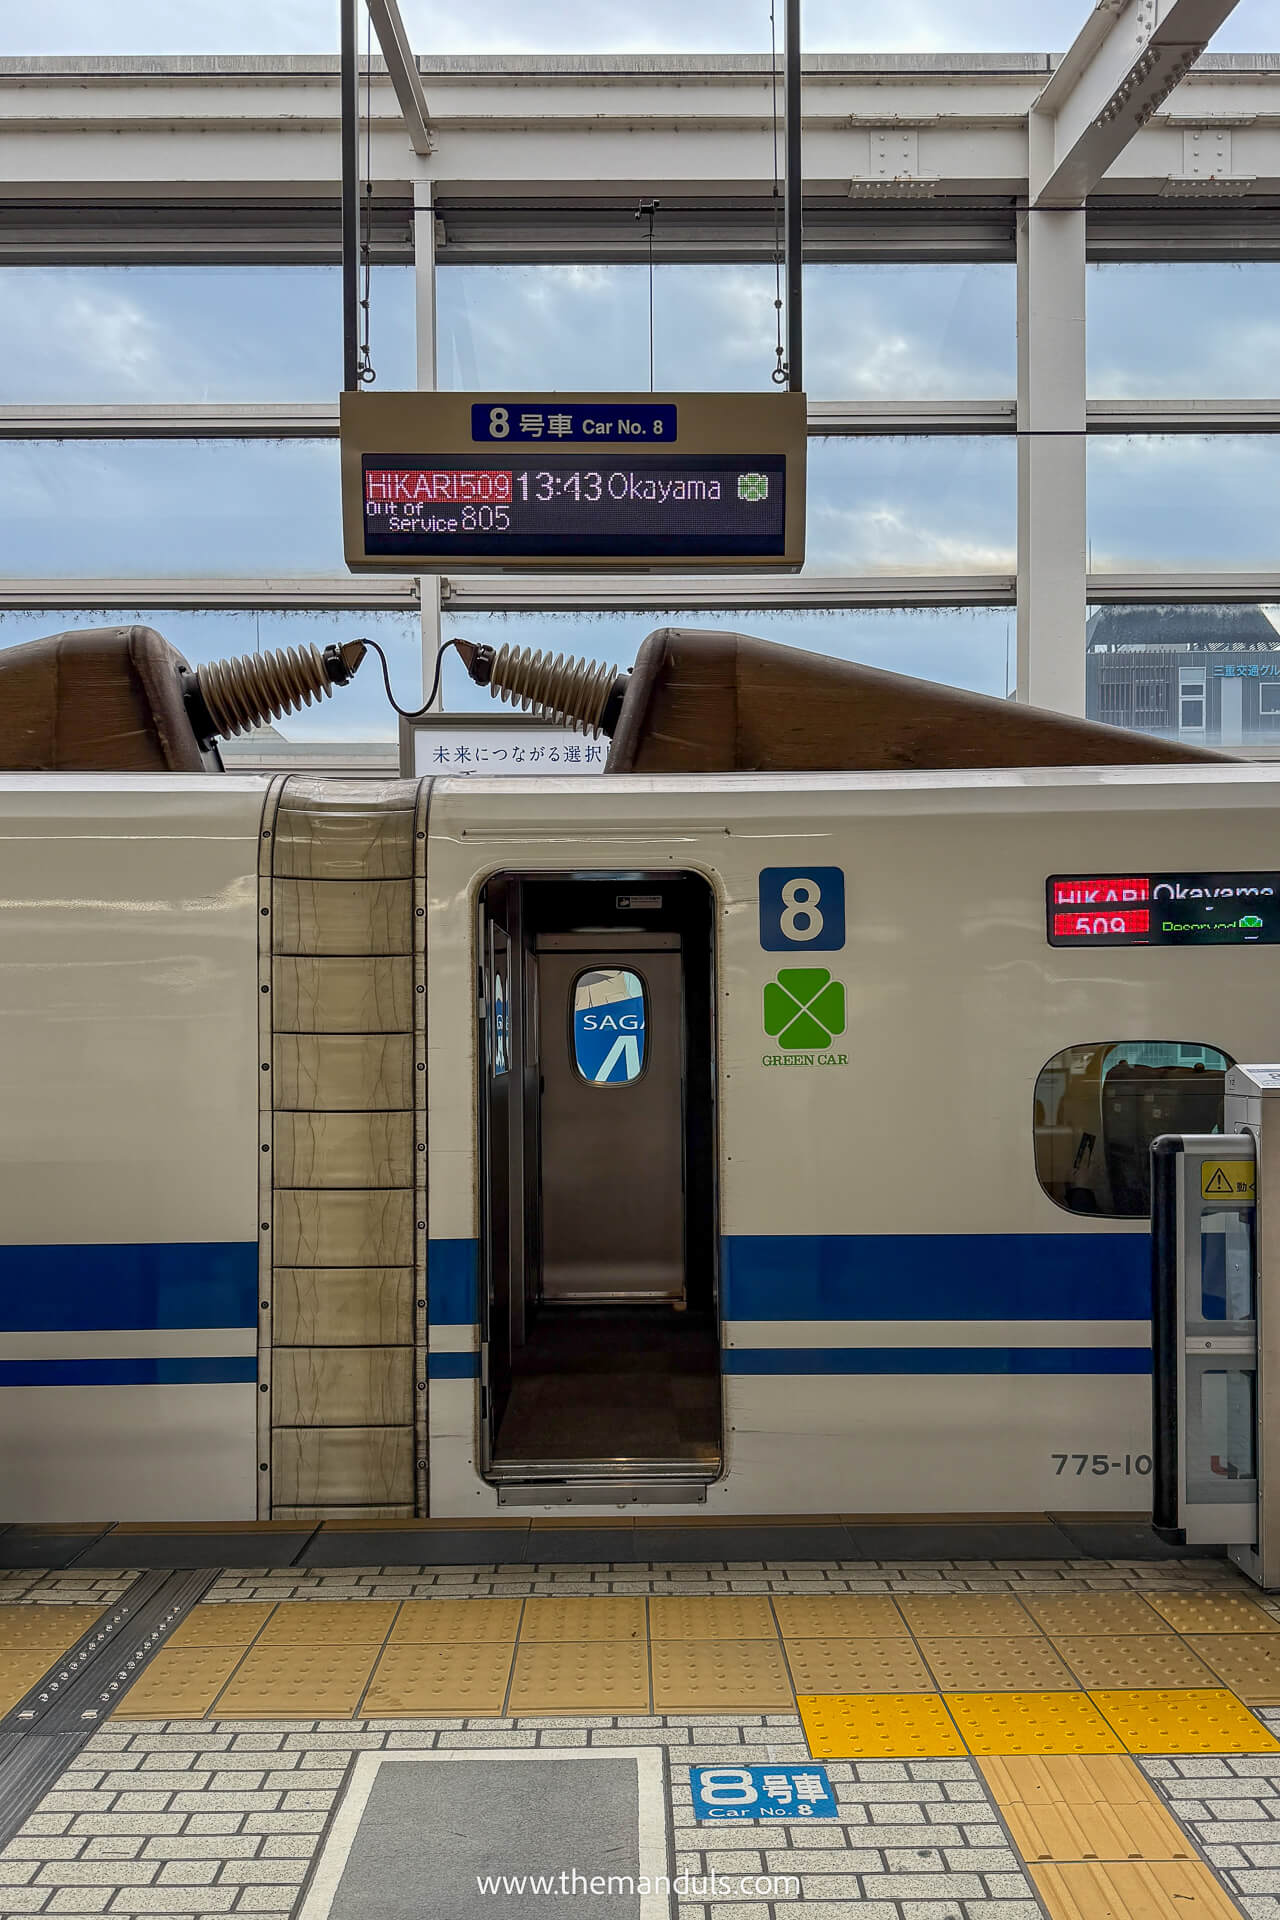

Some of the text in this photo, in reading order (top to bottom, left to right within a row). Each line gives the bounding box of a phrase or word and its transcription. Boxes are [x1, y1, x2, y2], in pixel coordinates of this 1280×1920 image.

[582, 419, 611, 435] Car
[617, 419, 647, 435] No.
[653, 420, 664, 435] 8
[517, 472, 602, 501] 13:43
[608, 474, 721, 503] Okayama
[366, 501, 424, 516] Out of
[461, 506, 510, 530] 805
[433, 745, 611, 764] 未来につながる選択
[780, 878, 824, 942] 8
[762, 1055, 848, 1067] GREEN CAR
[708, 1804, 813, 1818] Car No. 8
